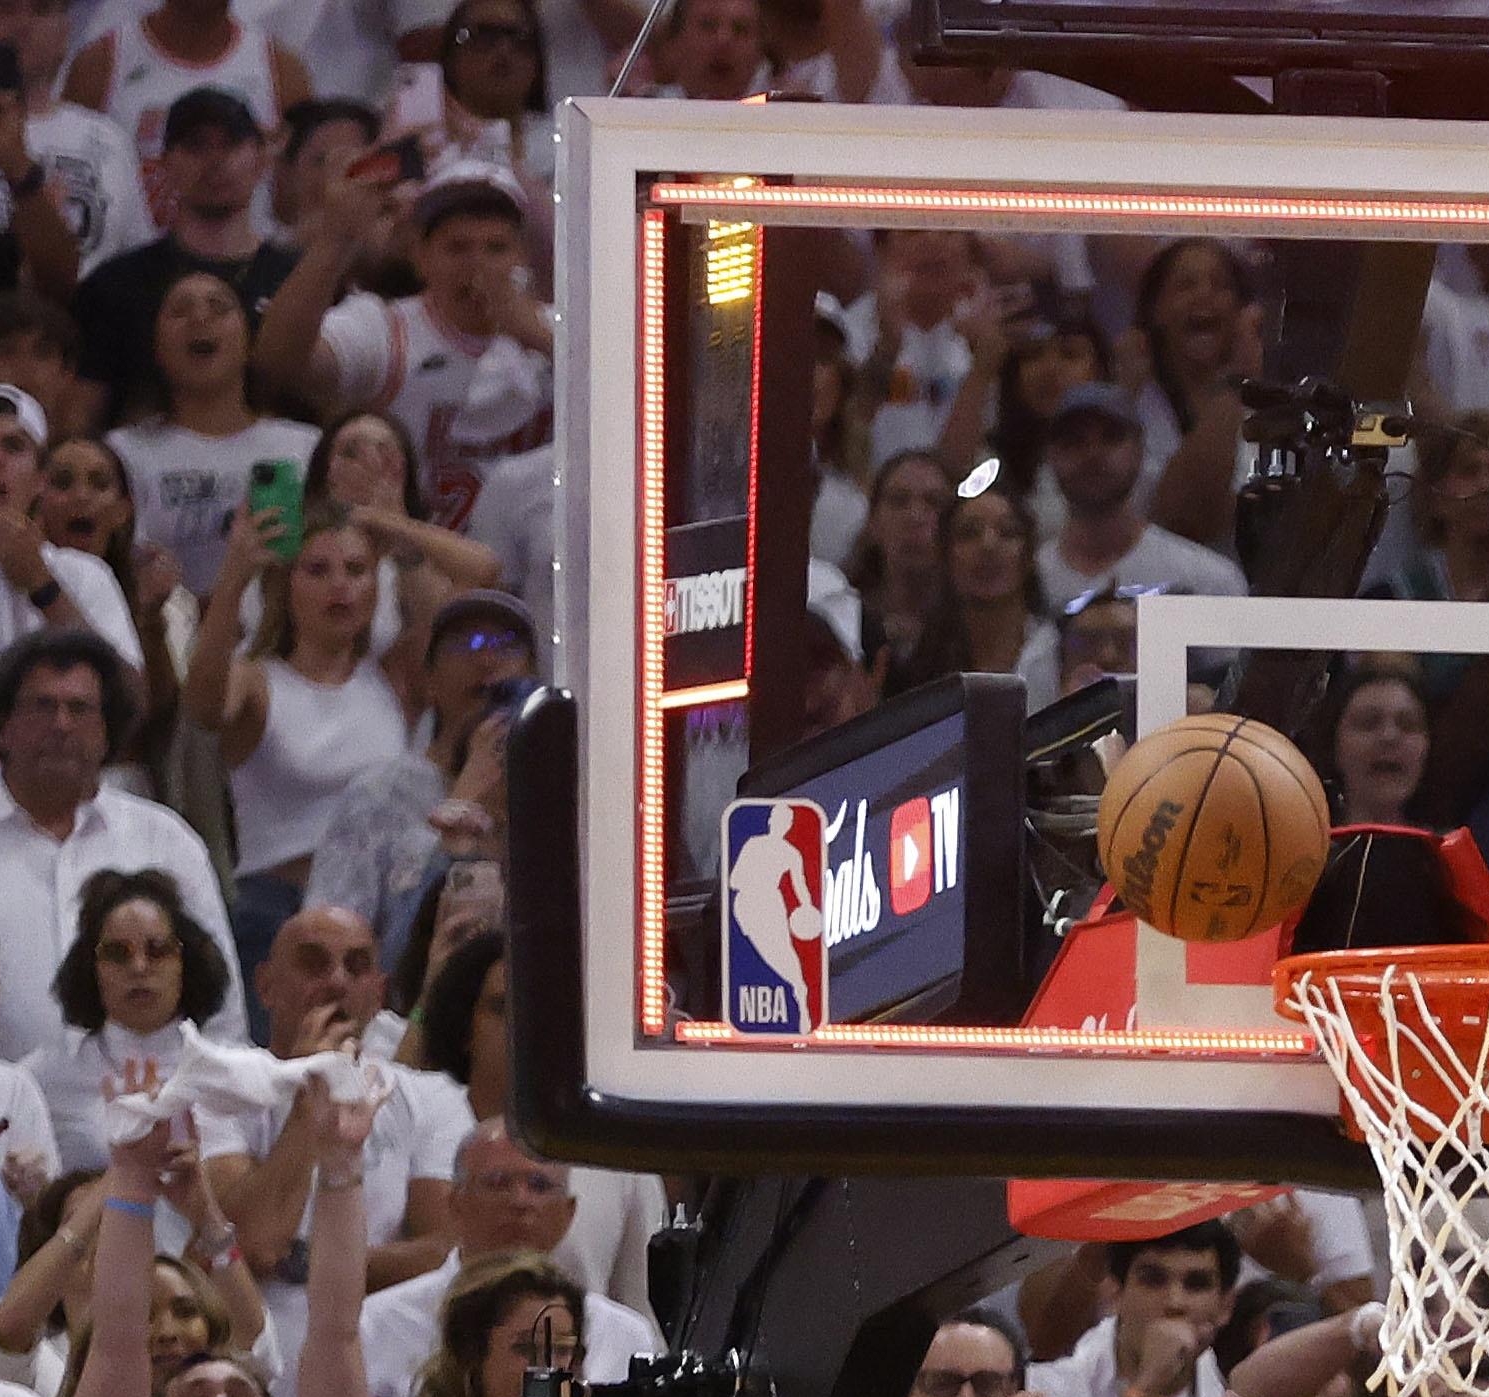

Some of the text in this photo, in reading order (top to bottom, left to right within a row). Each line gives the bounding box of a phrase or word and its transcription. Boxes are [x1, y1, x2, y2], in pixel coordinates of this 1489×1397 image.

[678, 568, 746, 634] TISSOT
[930, 787, 960, 896] TV
[739, 985, 789, 1024] NBA
